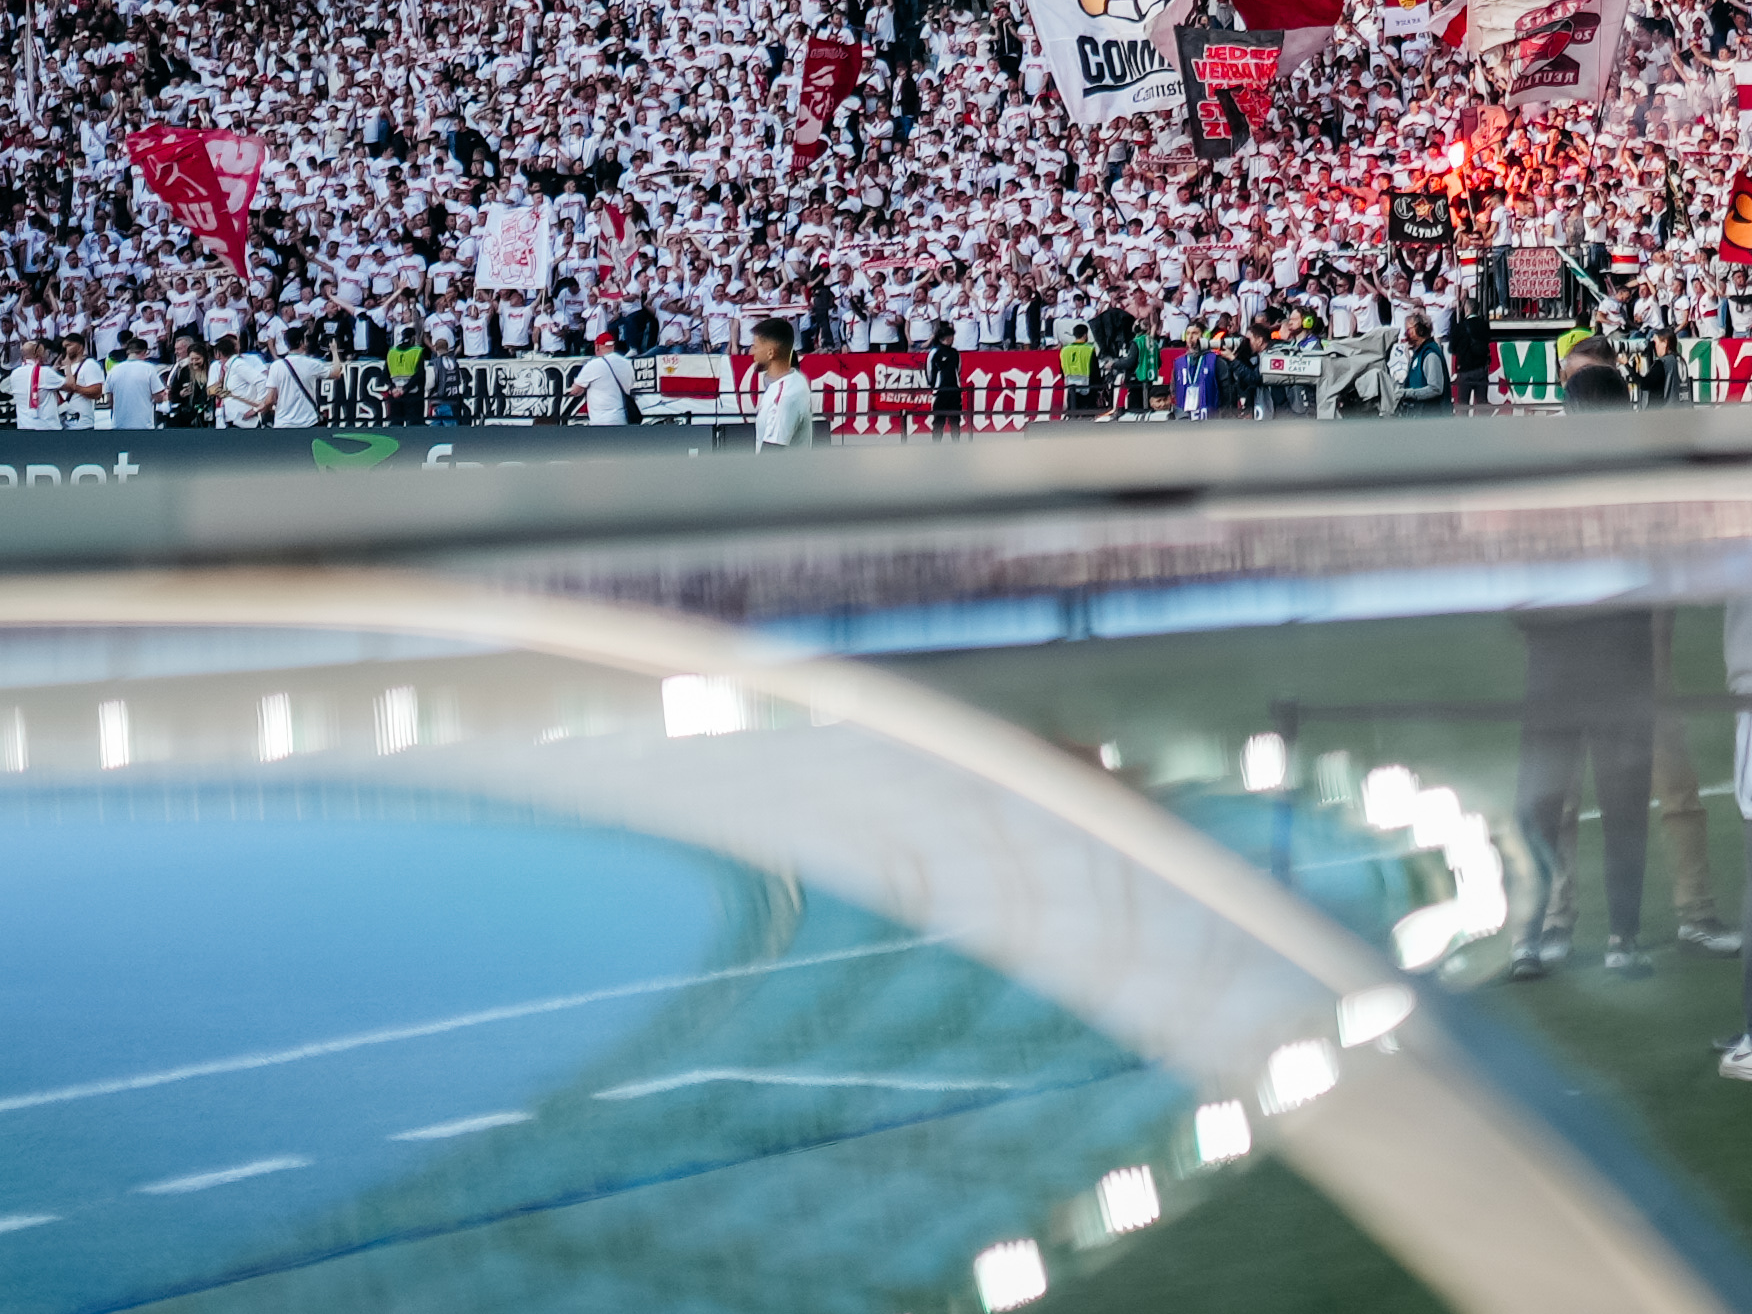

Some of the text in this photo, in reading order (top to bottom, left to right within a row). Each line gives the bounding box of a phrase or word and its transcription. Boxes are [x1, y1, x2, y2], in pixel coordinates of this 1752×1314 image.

[1075, 34, 1172, 86] COMM
[1192, 59, 1280, 84] VERBANN
[1132, 82, 1185, 104] Cannst
[1403, 222, 1444, 239] ULTRAS
